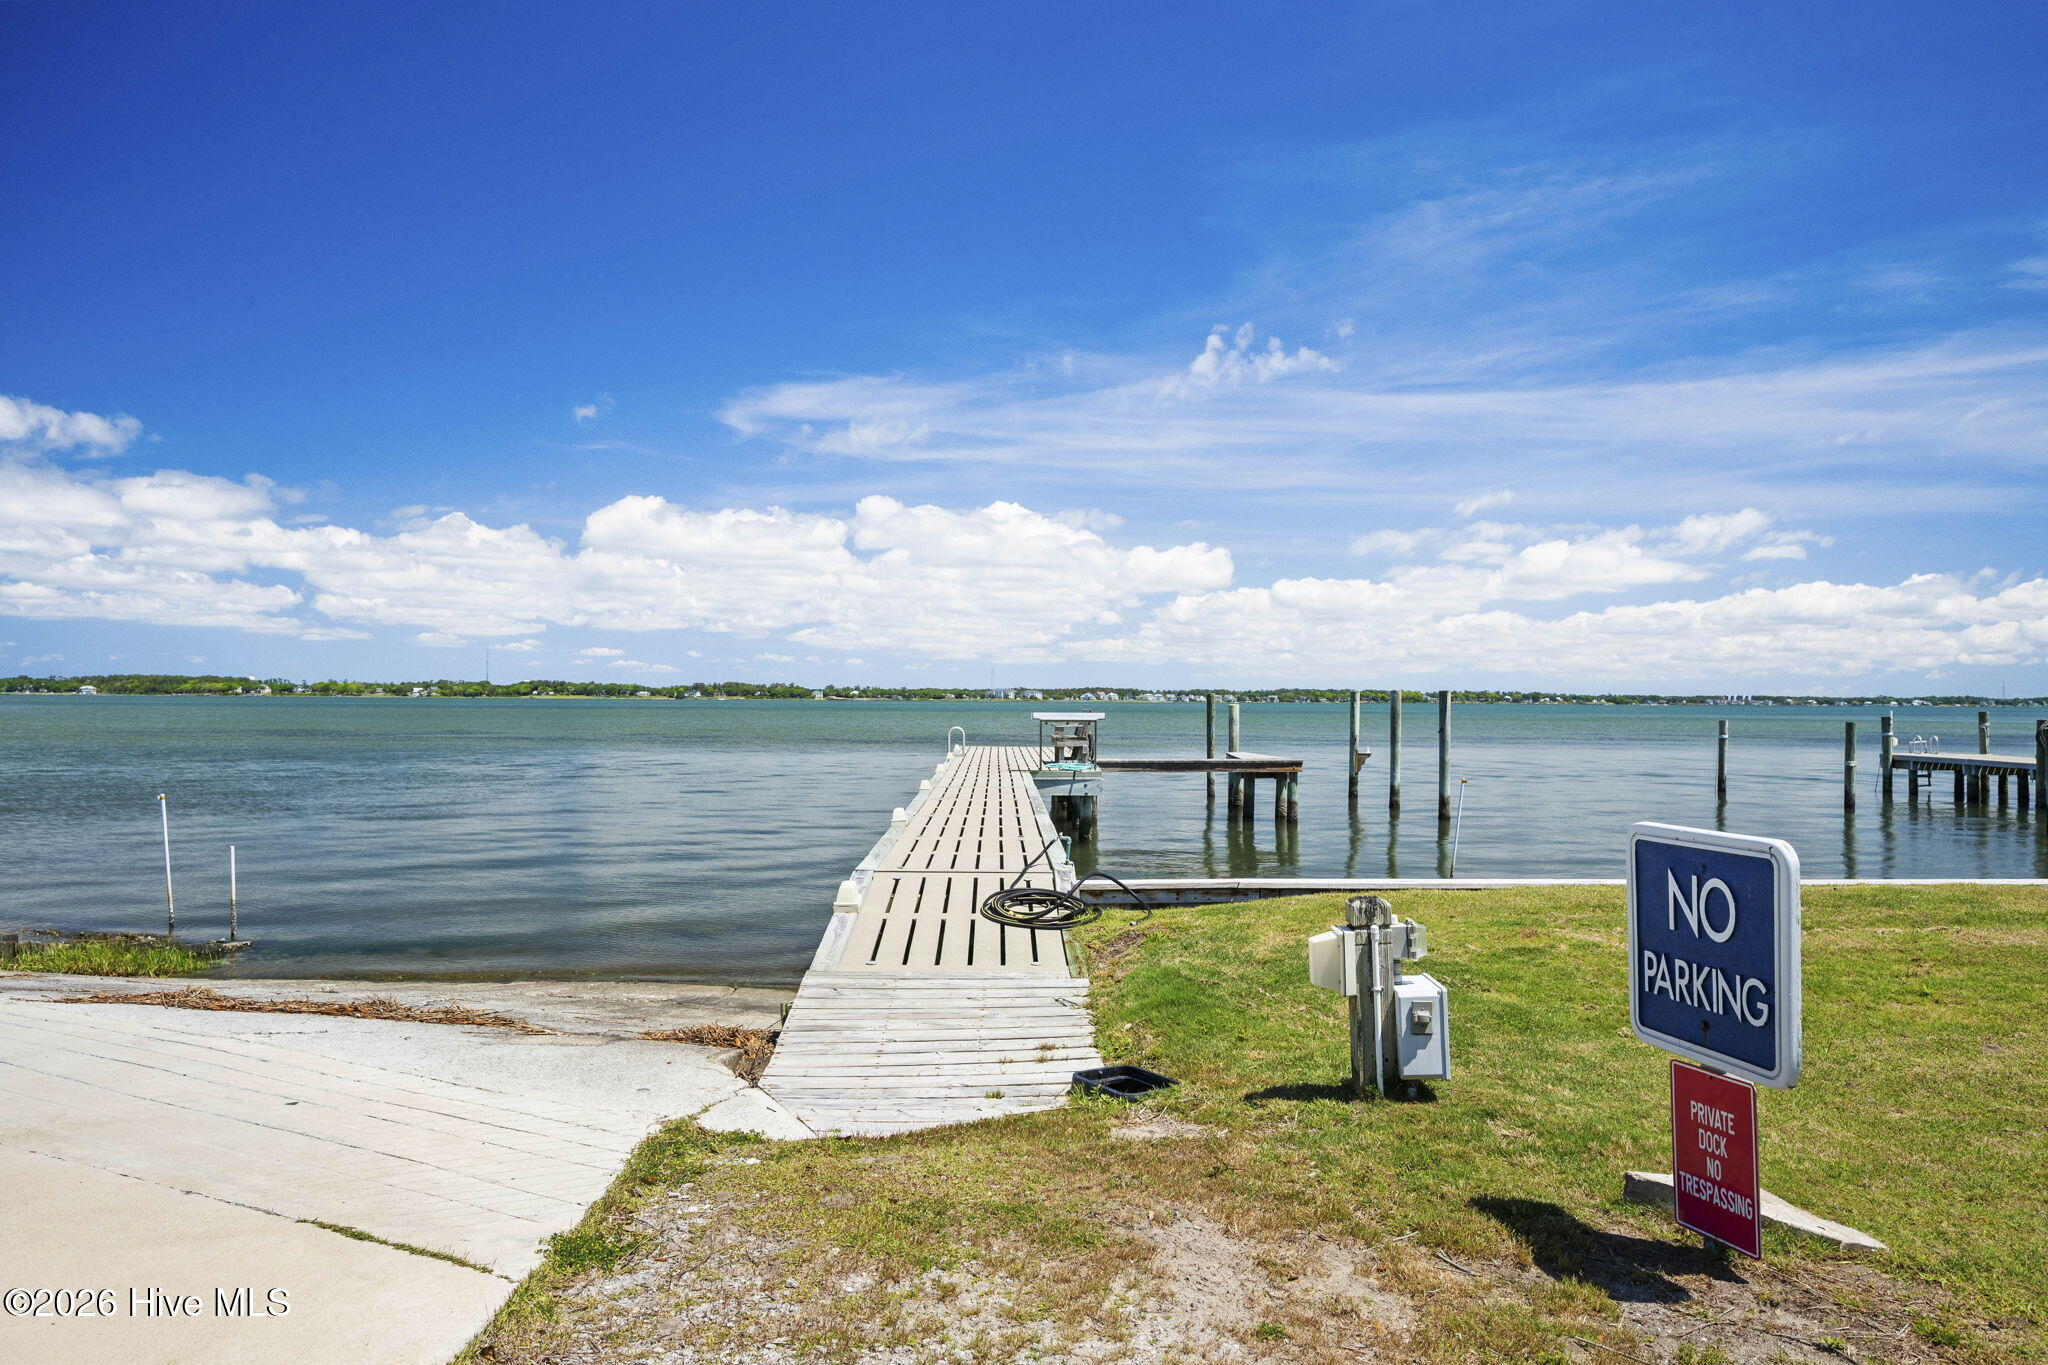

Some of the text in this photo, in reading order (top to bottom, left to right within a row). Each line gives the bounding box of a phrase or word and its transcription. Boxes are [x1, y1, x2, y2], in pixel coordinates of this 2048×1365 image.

[1668, 867, 1736, 943] NO
[1644, 950, 1769, 1027] PARKING
[1690, 1100, 1735, 1135] PRIVATE
[1698, 1129, 1728, 1158] DOCK
[1706, 1156, 1721, 1181] NO
[1679, 1171, 1753, 1220] TRESPASSING
